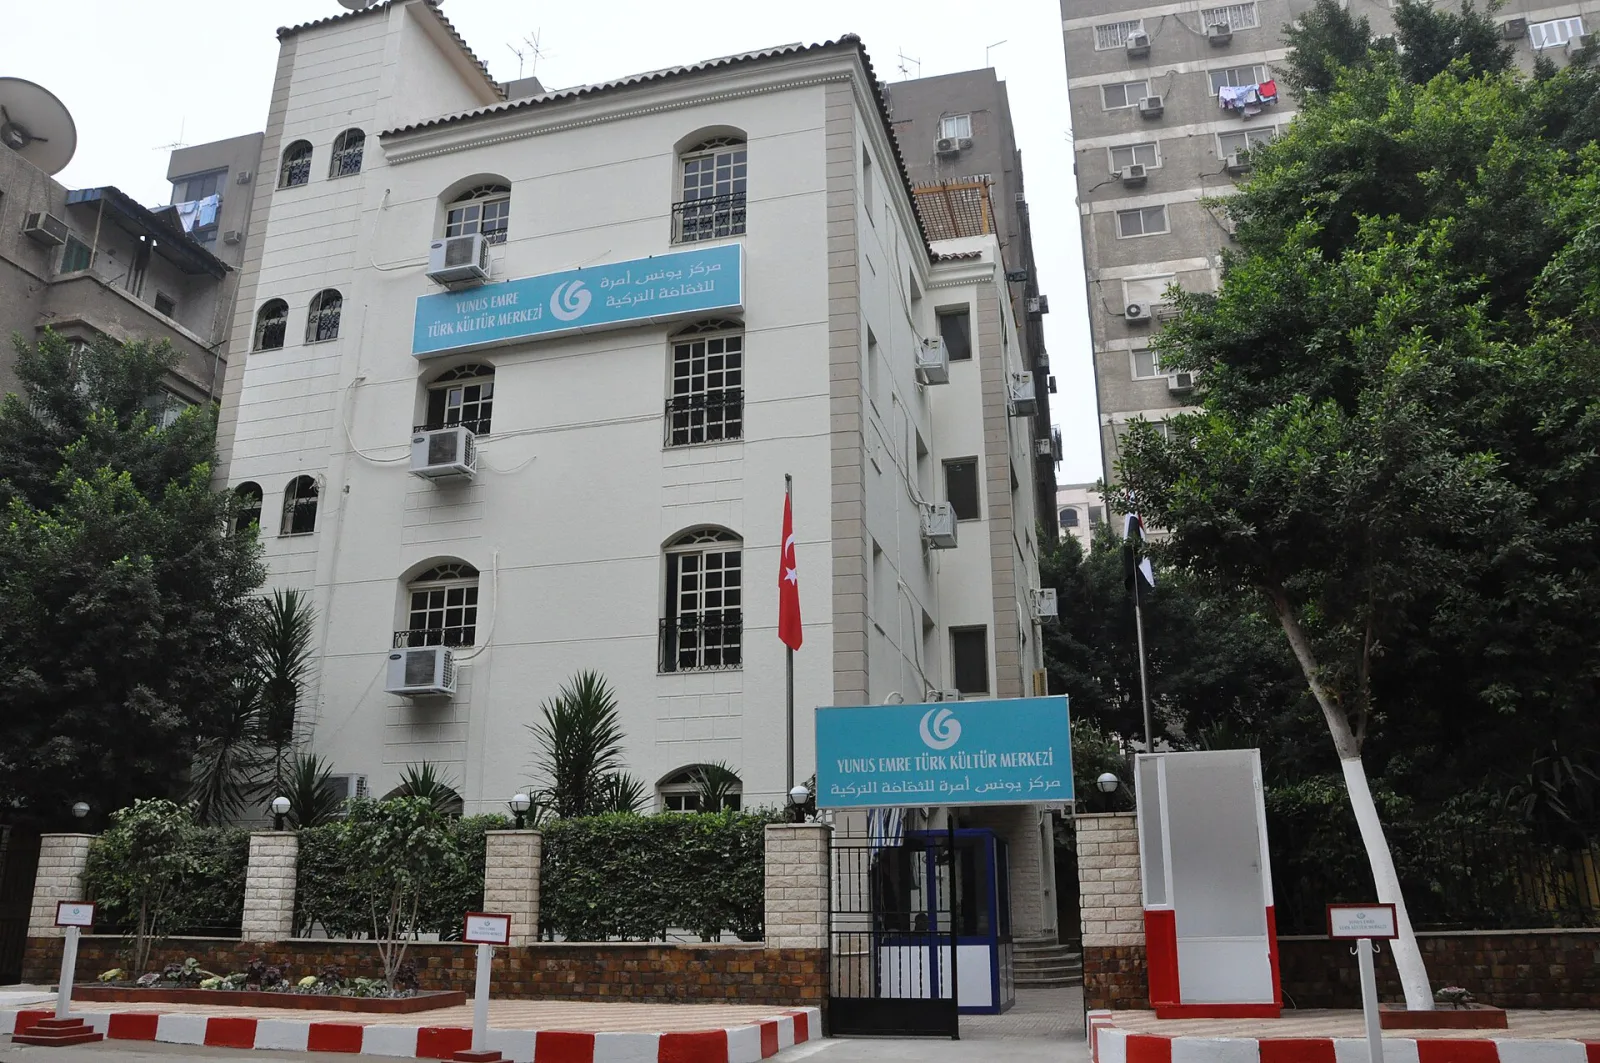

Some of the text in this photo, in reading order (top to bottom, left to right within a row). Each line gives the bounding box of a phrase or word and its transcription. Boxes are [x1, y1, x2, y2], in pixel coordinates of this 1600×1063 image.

[635, 268, 682, 285] يونس
[688, 260, 721, 279] مركز
[456, 292, 519, 314] YUNUS EMRE
[606, 279, 715, 309] للثقافة التركية
[428, 303, 542, 338] TÜRK KÜLTÜR MERKEZİ
[837, 746, 1053, 774] YUNUS EMRE TÜRK KÜLTÜR MERKEZİ
[830, 781, 877, 798] التركية
[881, 780, 935, 793] للثقافة
[974, 779, 1022, 793] يونس
[1027, 775, 1061, 792] مركز
